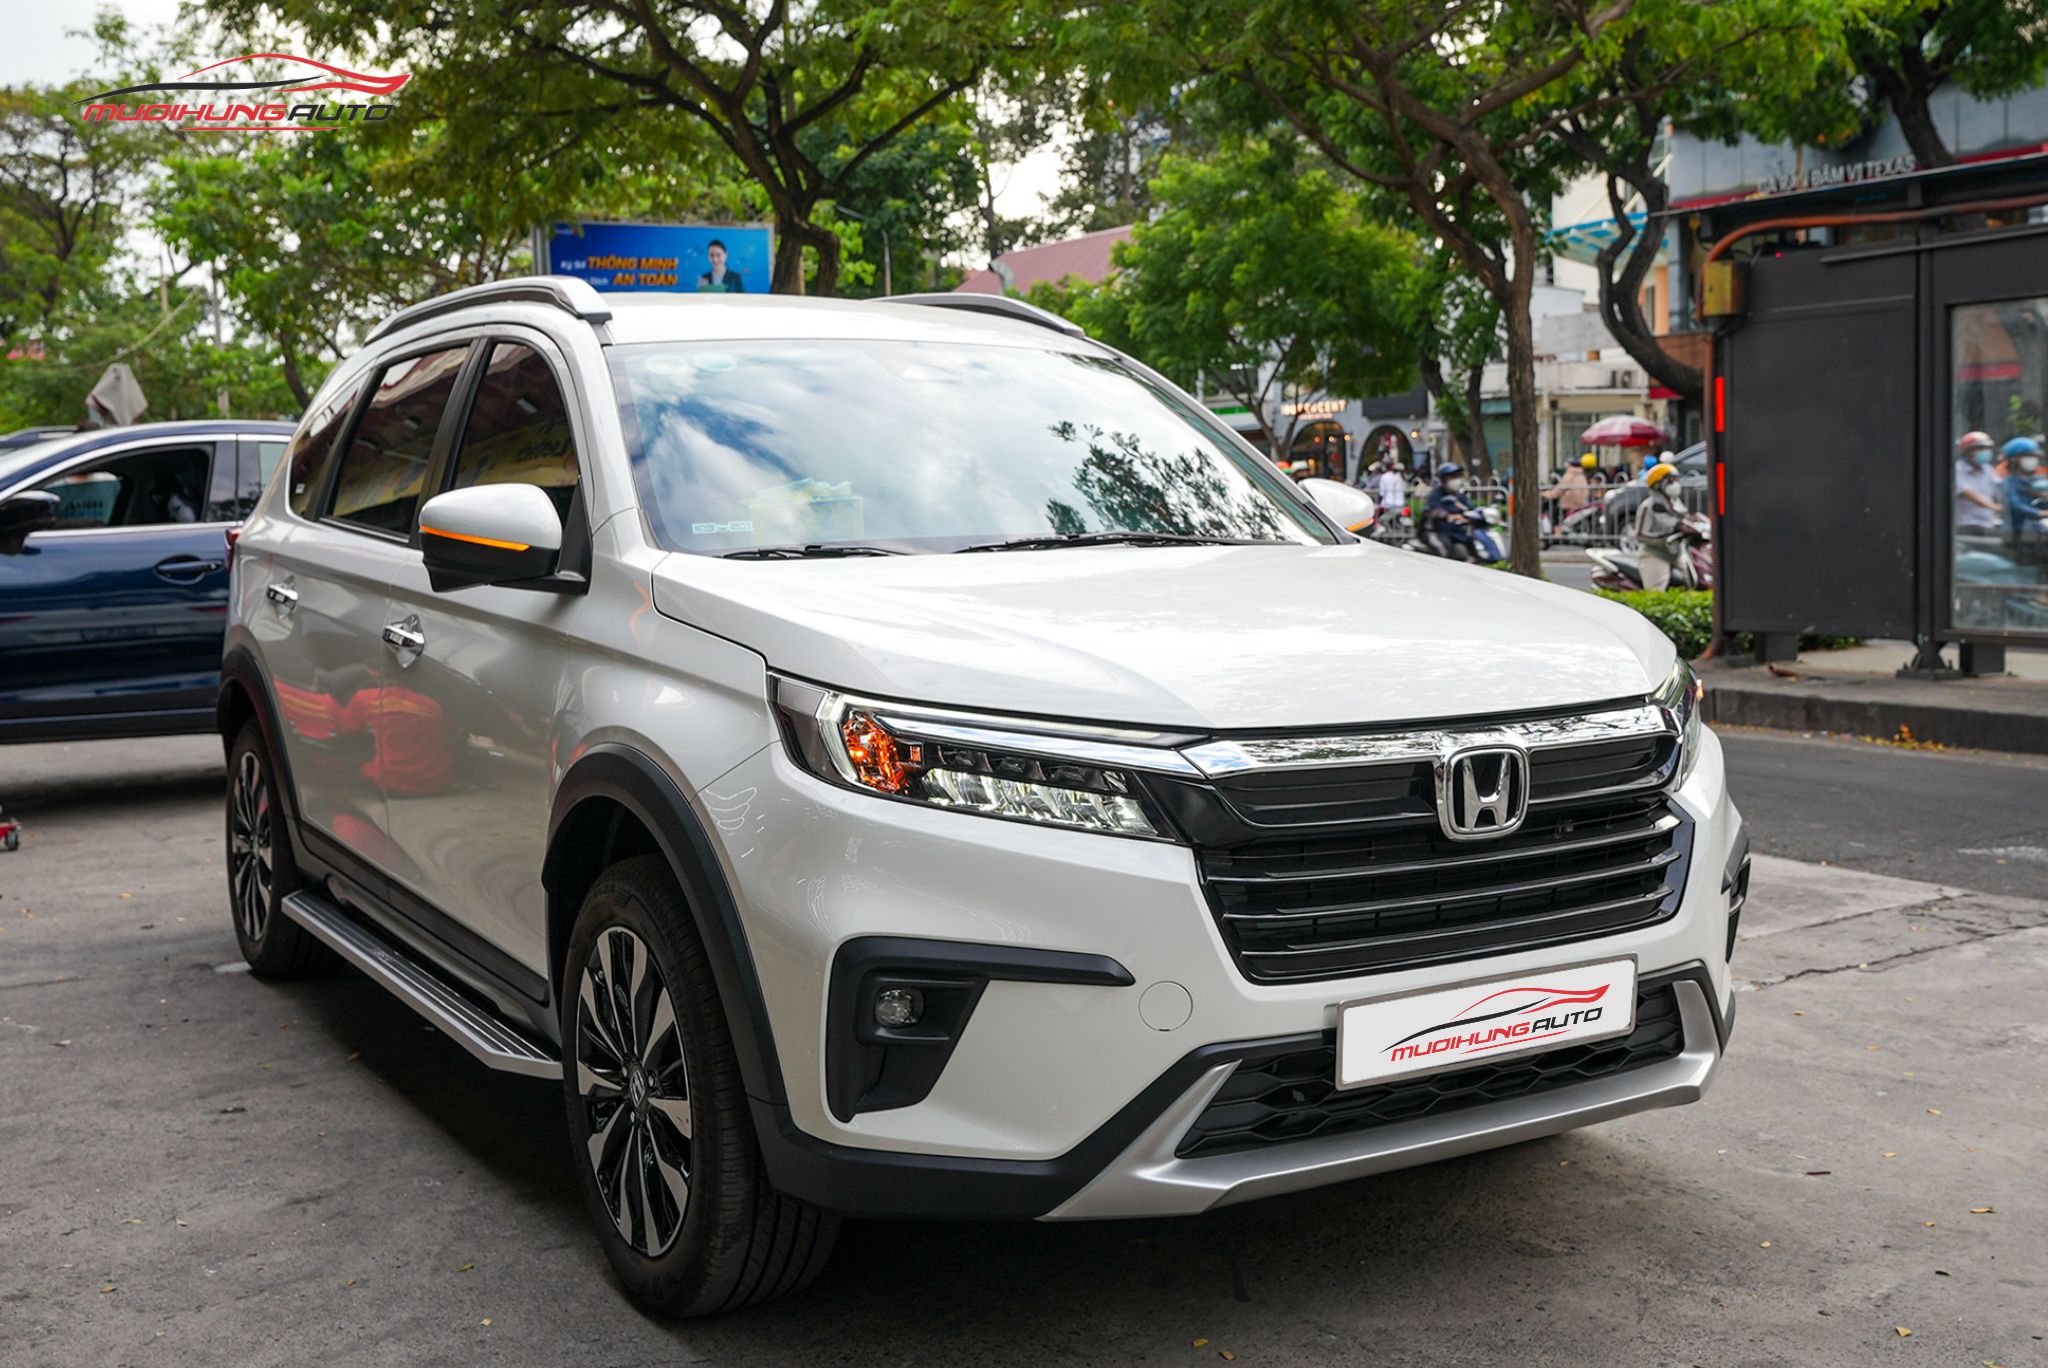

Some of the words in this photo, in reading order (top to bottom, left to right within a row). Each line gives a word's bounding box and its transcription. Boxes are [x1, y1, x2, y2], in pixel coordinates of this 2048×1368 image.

[1867, 154, 1916, 178] TEXAS
[588, 254, 638, 269] THÔNG
[640, 257, 678, 269] MINH
[612, 273, 635, 285] AN
[638, 271, 678, 285] TOÀN
